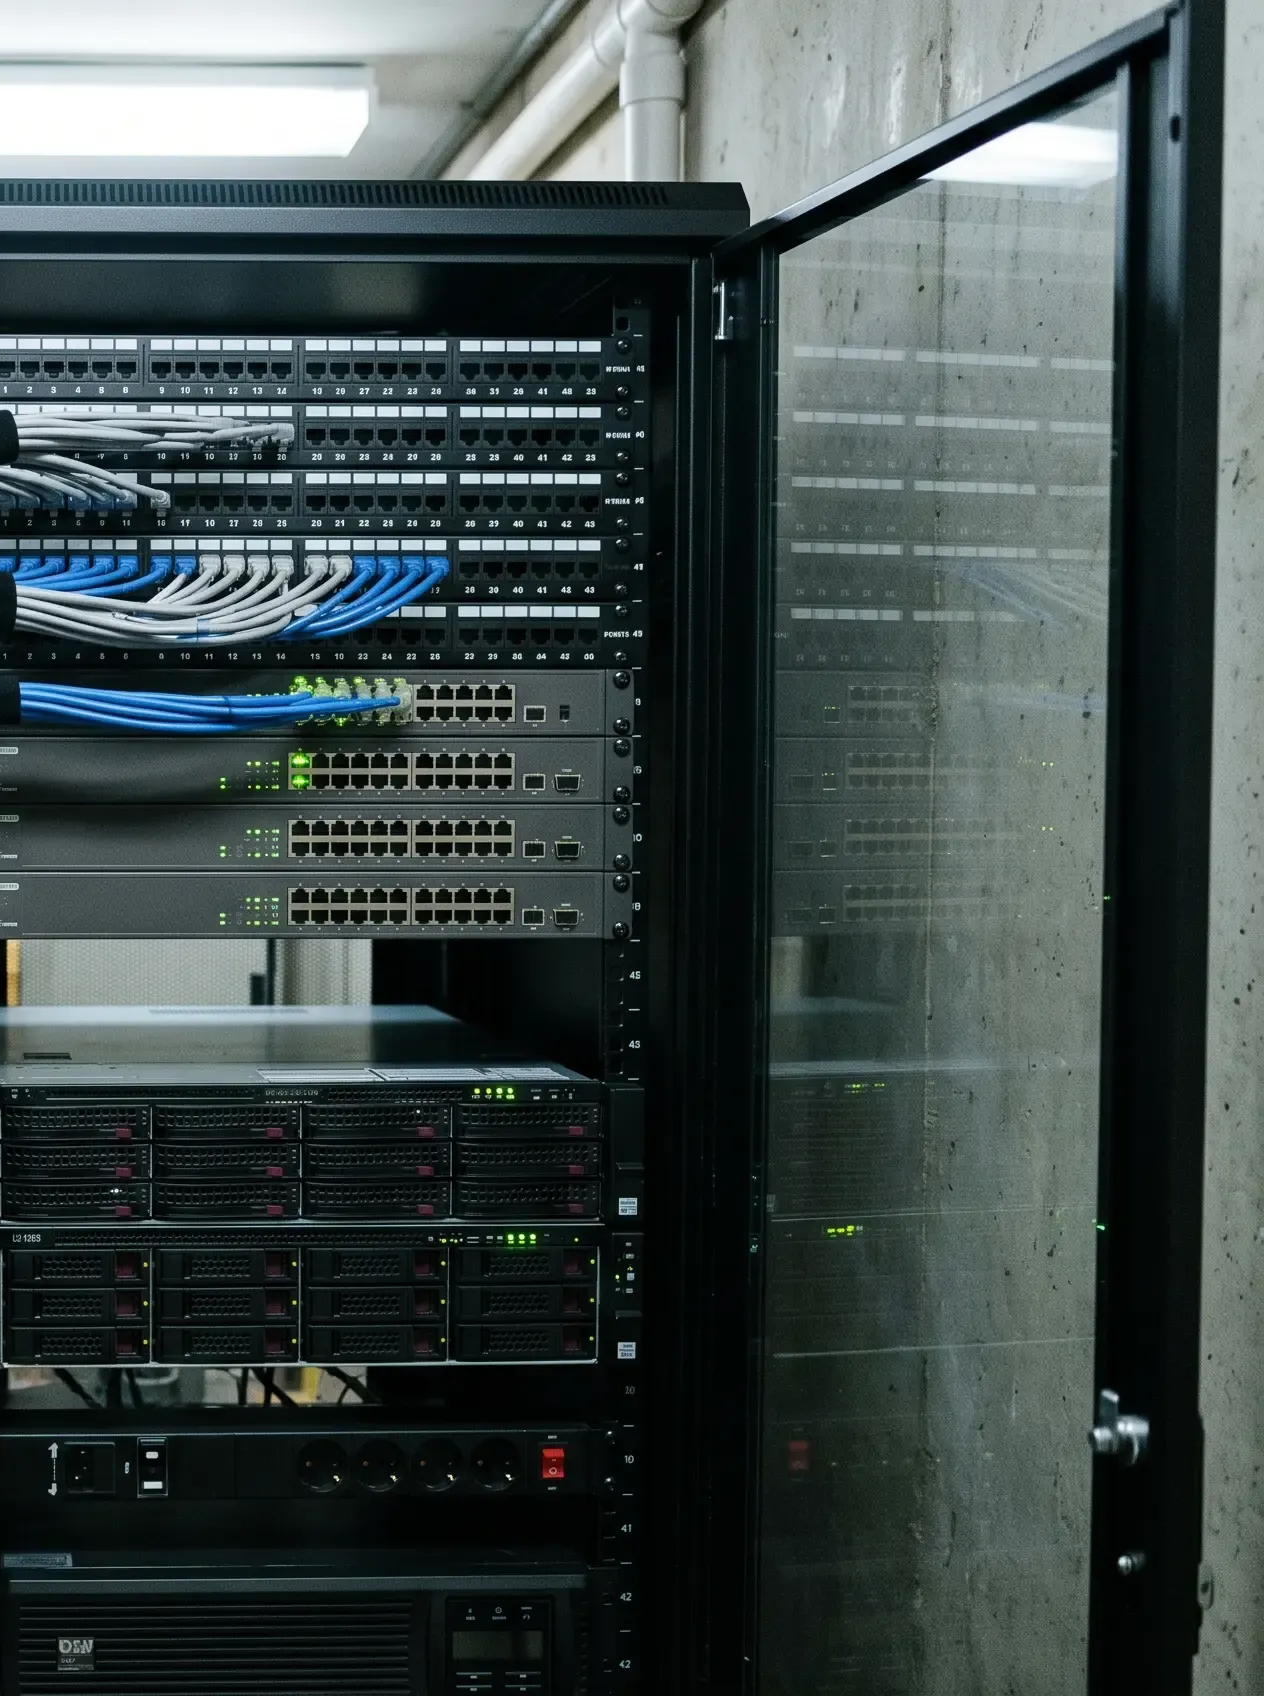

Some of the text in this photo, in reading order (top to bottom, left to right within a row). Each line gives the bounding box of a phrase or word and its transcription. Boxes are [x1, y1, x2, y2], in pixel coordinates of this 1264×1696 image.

[3, 385, 8, 394] 1
[26, 386, 33, 394] 2
[75, 386, 81, 394] 4
[159, 386, 165, 395] 9
[180, 386, 191, 394] 10
[203, 386, 214, 395] 11
[252, 386, 263, 395] 13
[358, 387, 370, 395] 27
[358, 519, 370, 527] 22
[536, 586, 547, 594] 41
[3, 652, 7, 660] 1
[27, 652, 33, 660] 2
[228, 652, 238, 660] 12
[619, 1592, 632, 1602] 42
